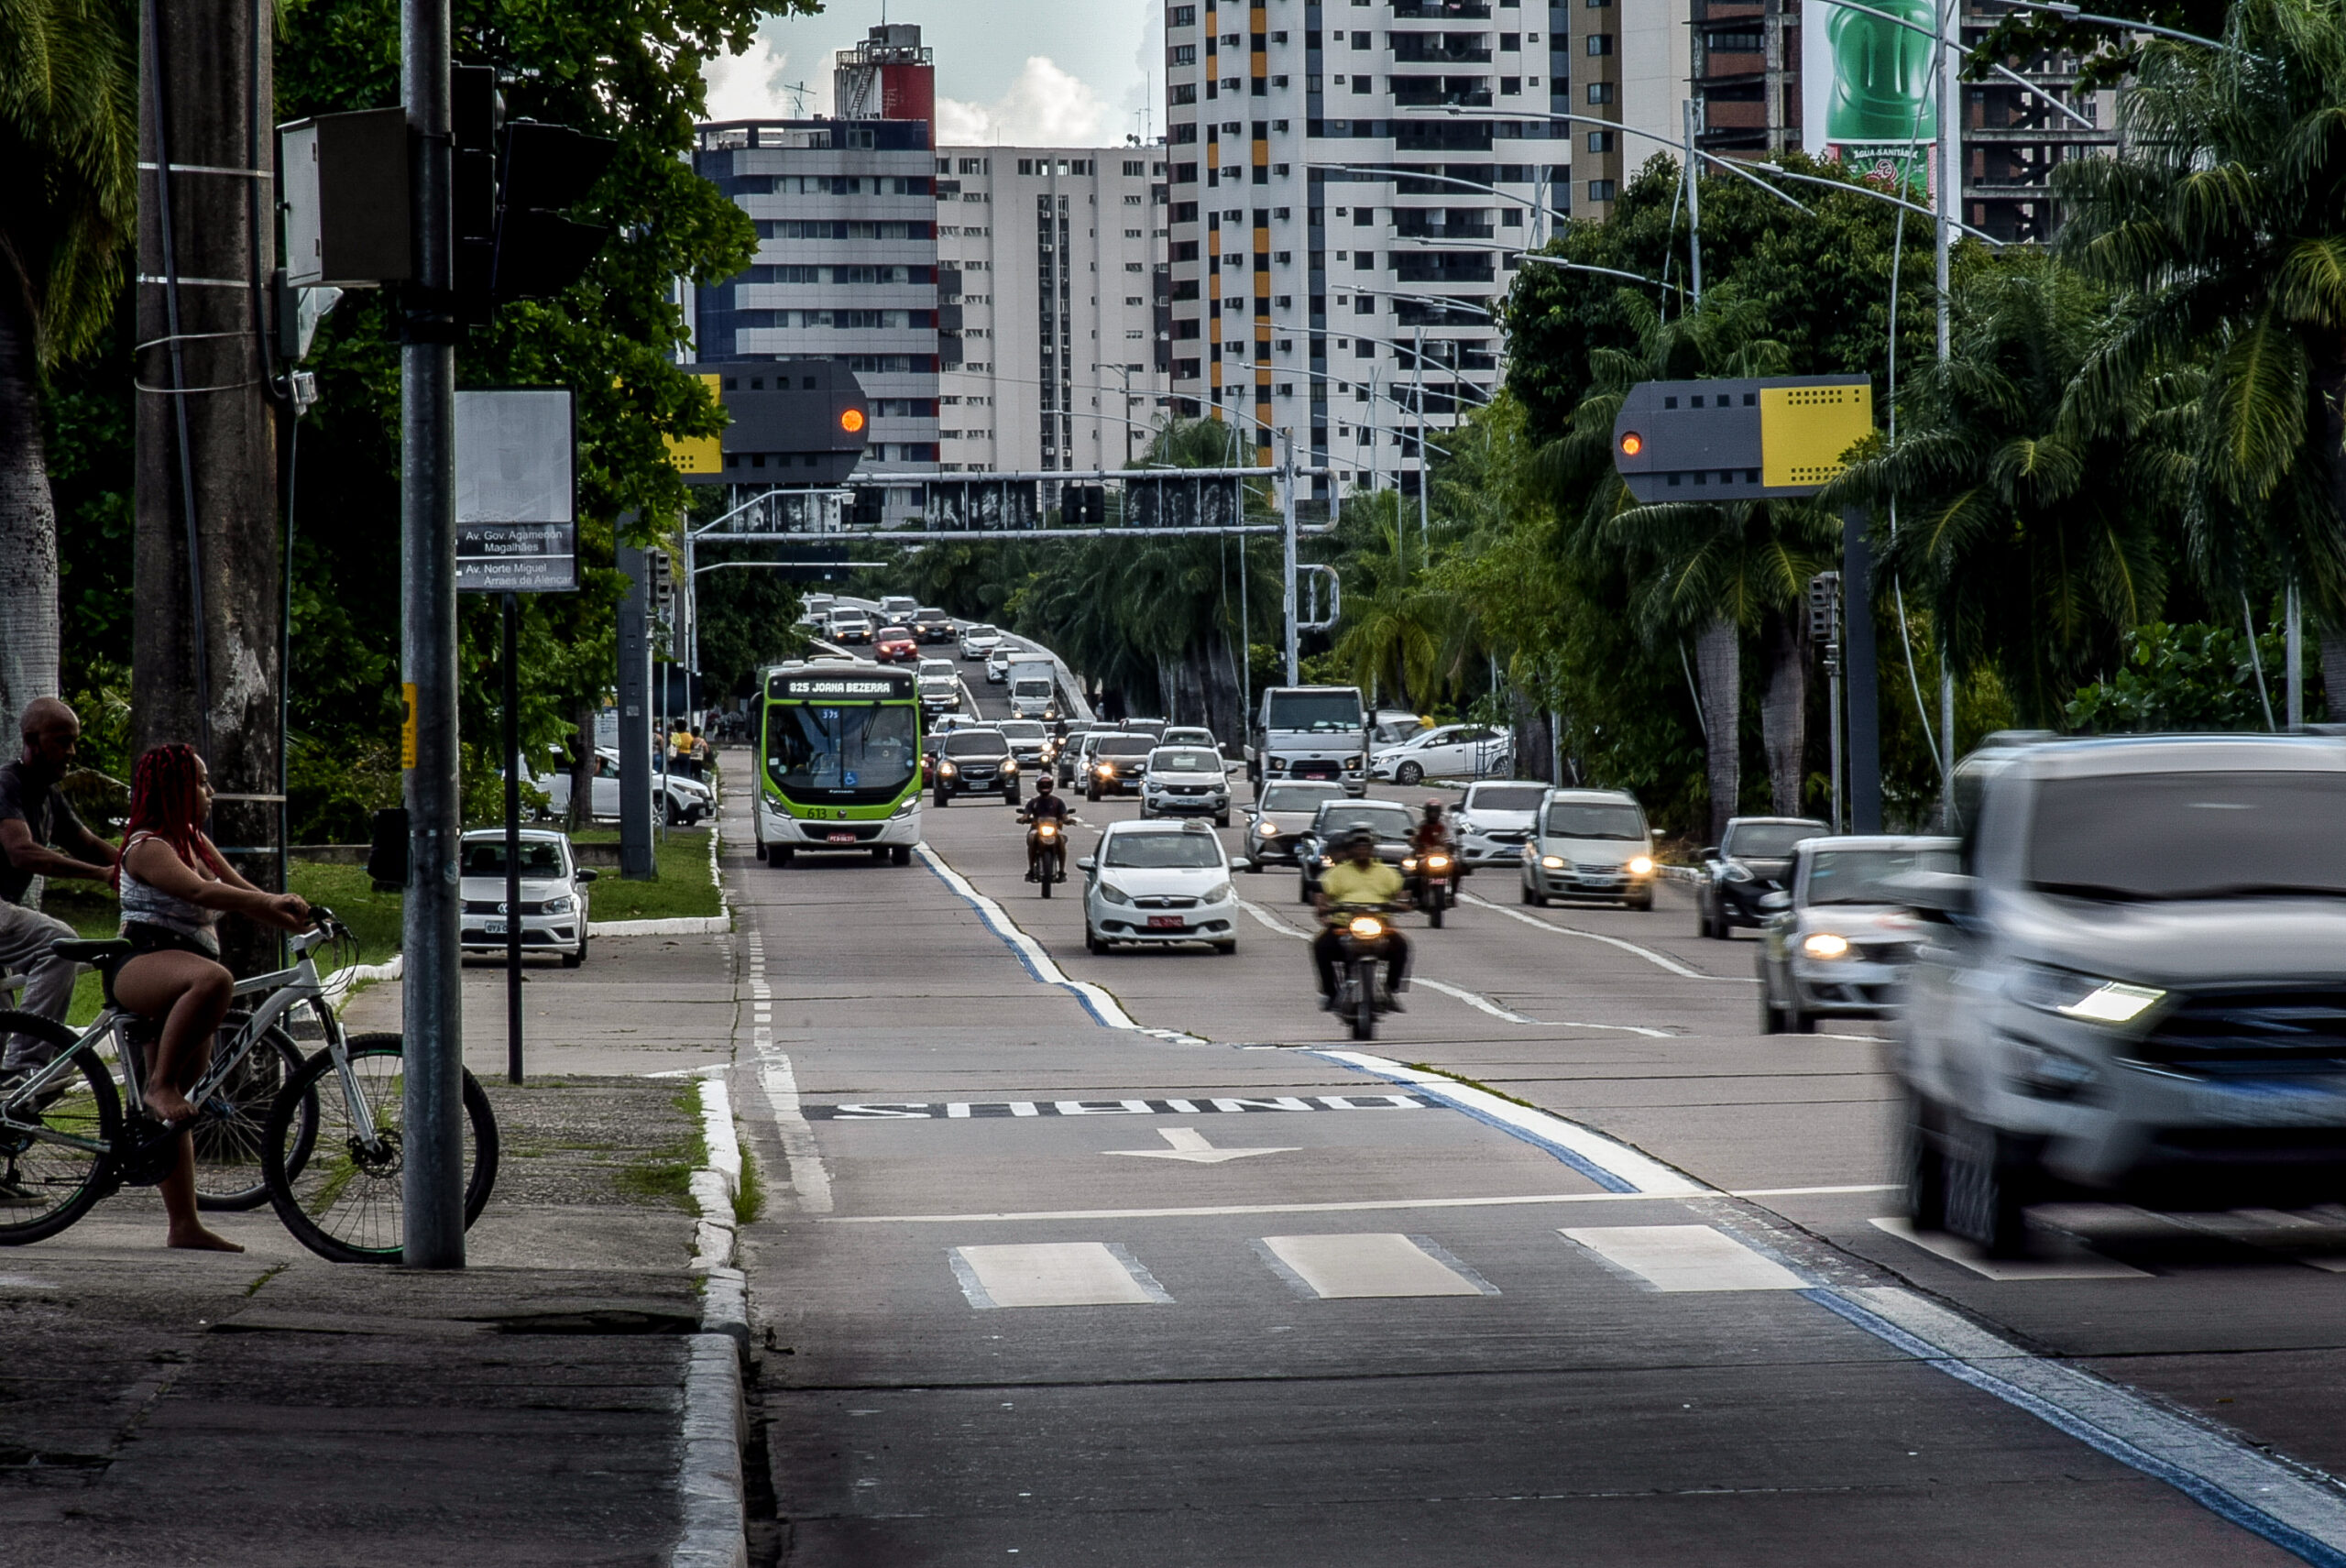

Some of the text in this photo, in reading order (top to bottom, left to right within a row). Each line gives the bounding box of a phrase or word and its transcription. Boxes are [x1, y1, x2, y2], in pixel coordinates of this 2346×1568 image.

[466, 532, 481, 541] Av.
[484, 531, 507, 541] Gov.
[485, 543, 539, 554] Magalhães
[466, 563, 547, 576] Av. Norte Miguel
[484, 576, 572, 587] Arraes de Alencar
[846, 682, 891, 693] BEZERRA
[806, 807, 828, 819] 613
